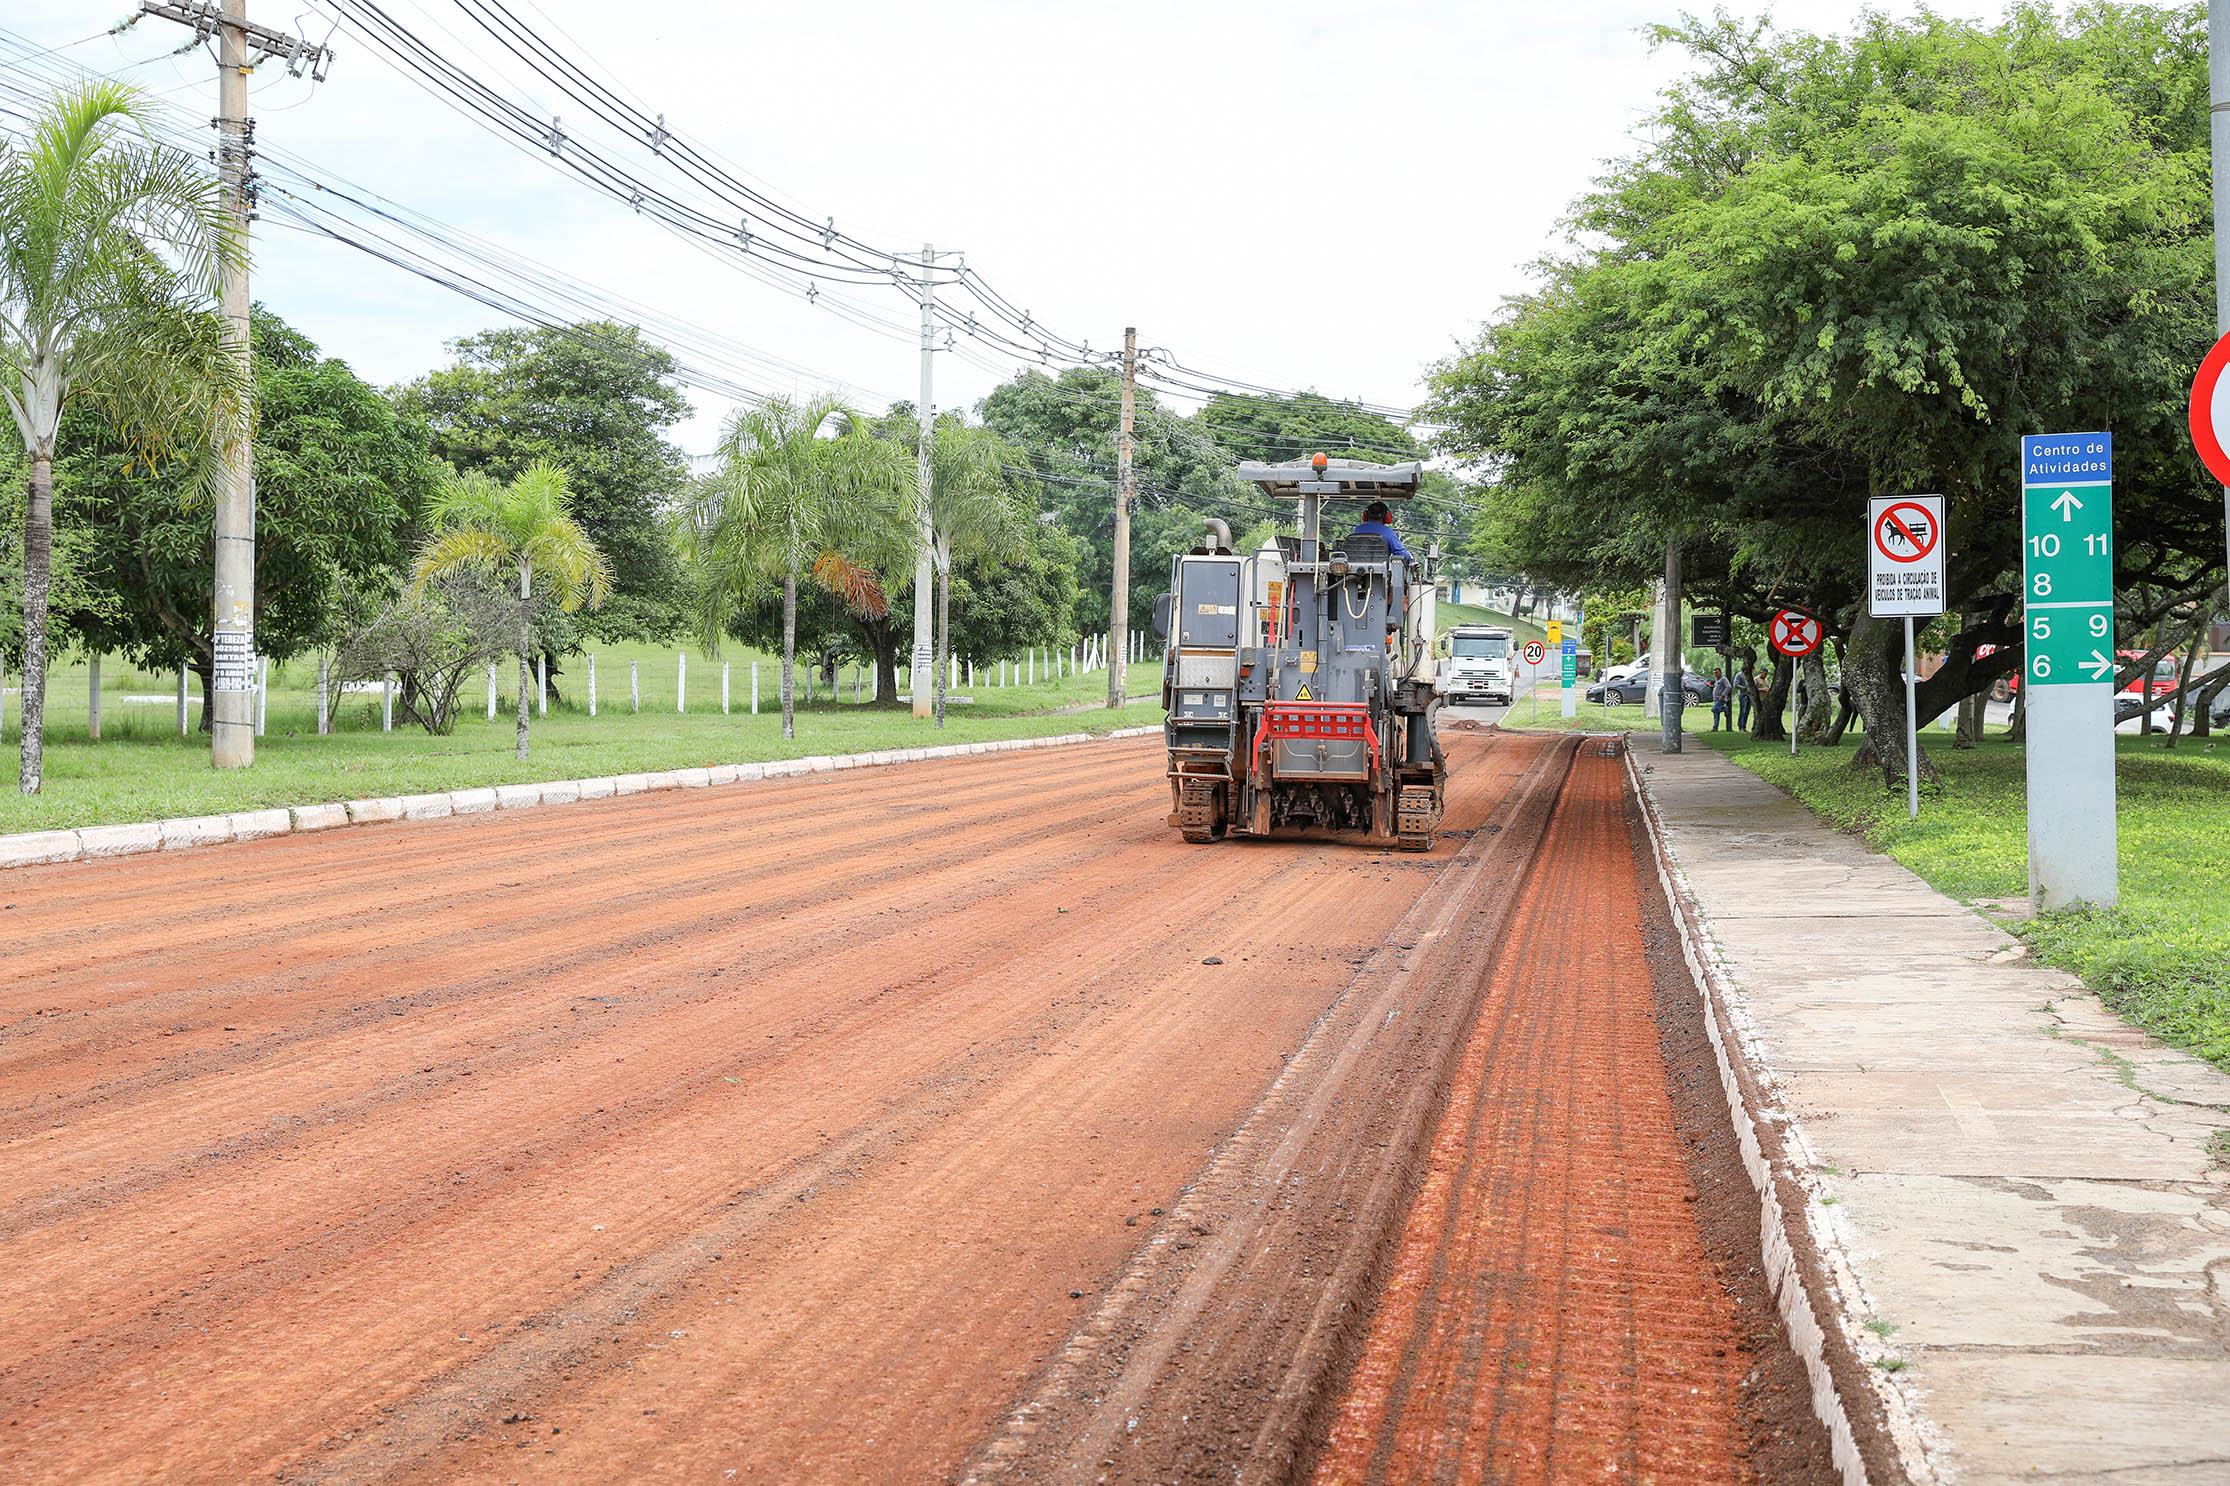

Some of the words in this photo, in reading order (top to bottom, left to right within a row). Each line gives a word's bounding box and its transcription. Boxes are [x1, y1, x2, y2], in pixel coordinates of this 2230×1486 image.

[2033, 444, 2080, 457] Centro
[2086, 442, 2104, 454] de
[2029, 460, 2107, 475] Atividades
[2028, 533, 2061, 558] 10
[2083, 533, 2108, 556] 11
[1931, 572, 1937, 584] DE
[2033, 573, 2052, 596] 8
[1897, 588, 1903, 601] DE
[2032, 617, 2051, 640] 5
[2088, 614, 2108, 638] 9
[1527, 645, 1542, 658] 20
[2032, 654, 2051, 678] 6
